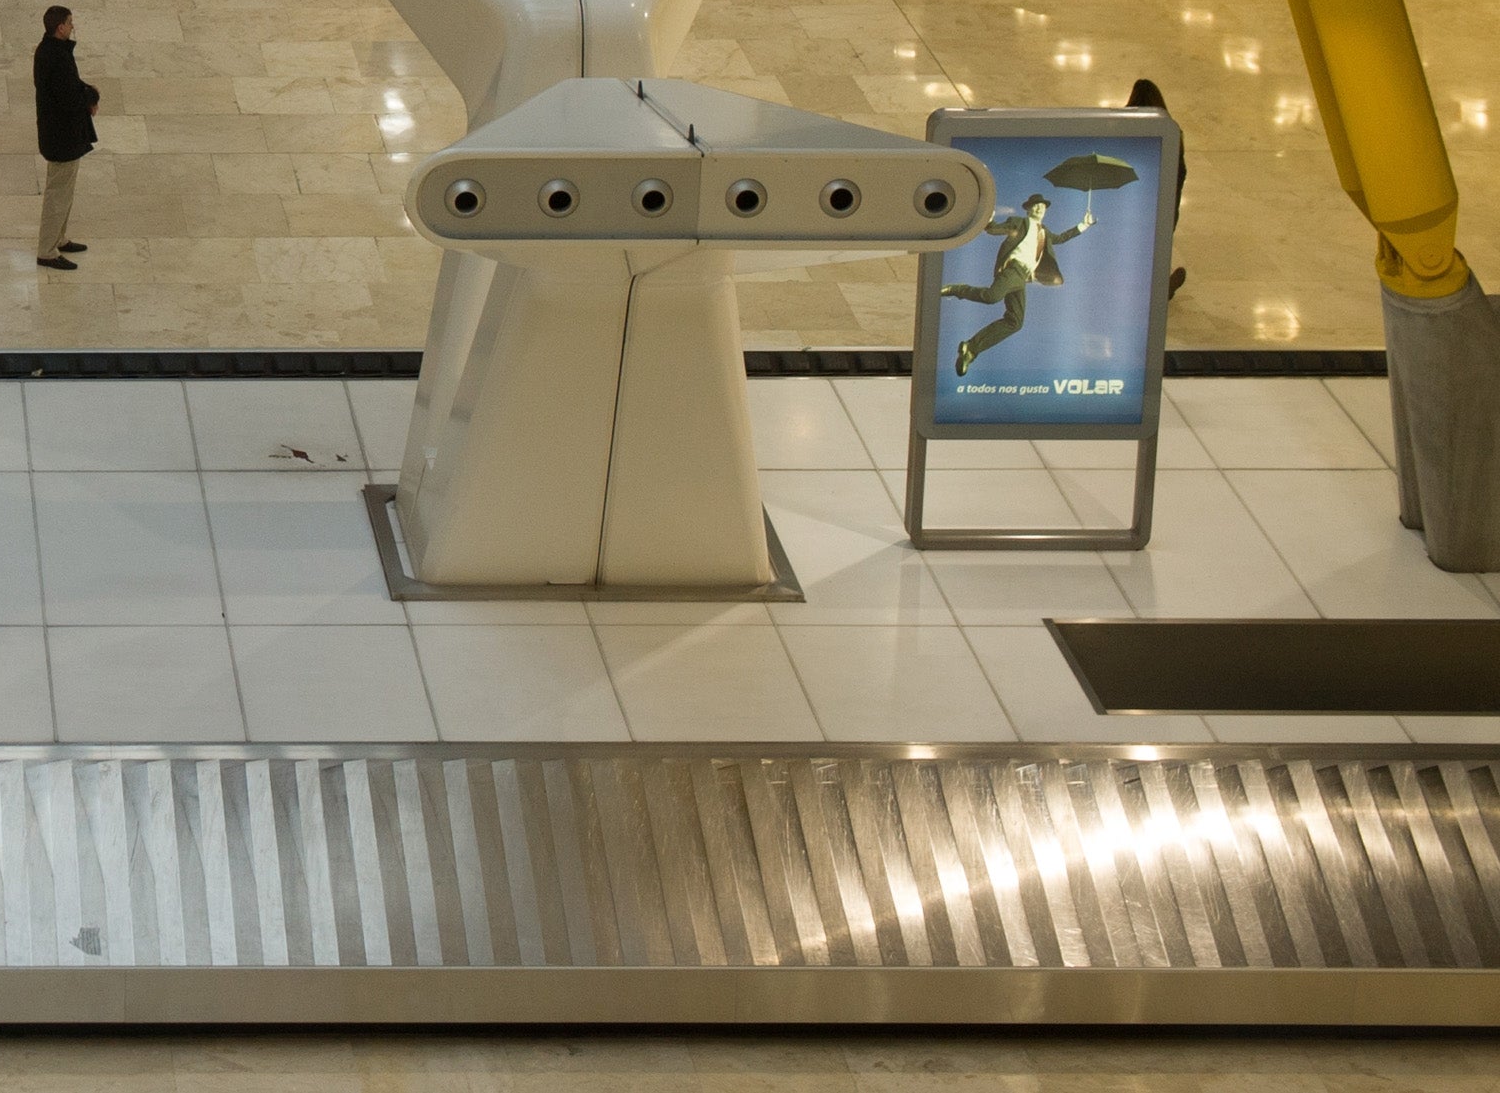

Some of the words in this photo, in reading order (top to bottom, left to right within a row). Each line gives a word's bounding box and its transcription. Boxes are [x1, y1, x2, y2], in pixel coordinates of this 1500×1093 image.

[957, 385, 964, 393] a
[967, 383, 996, 394] todos
[999, 385, 1018, 394] nos
[1020, 384, 1049, 395] gusta
